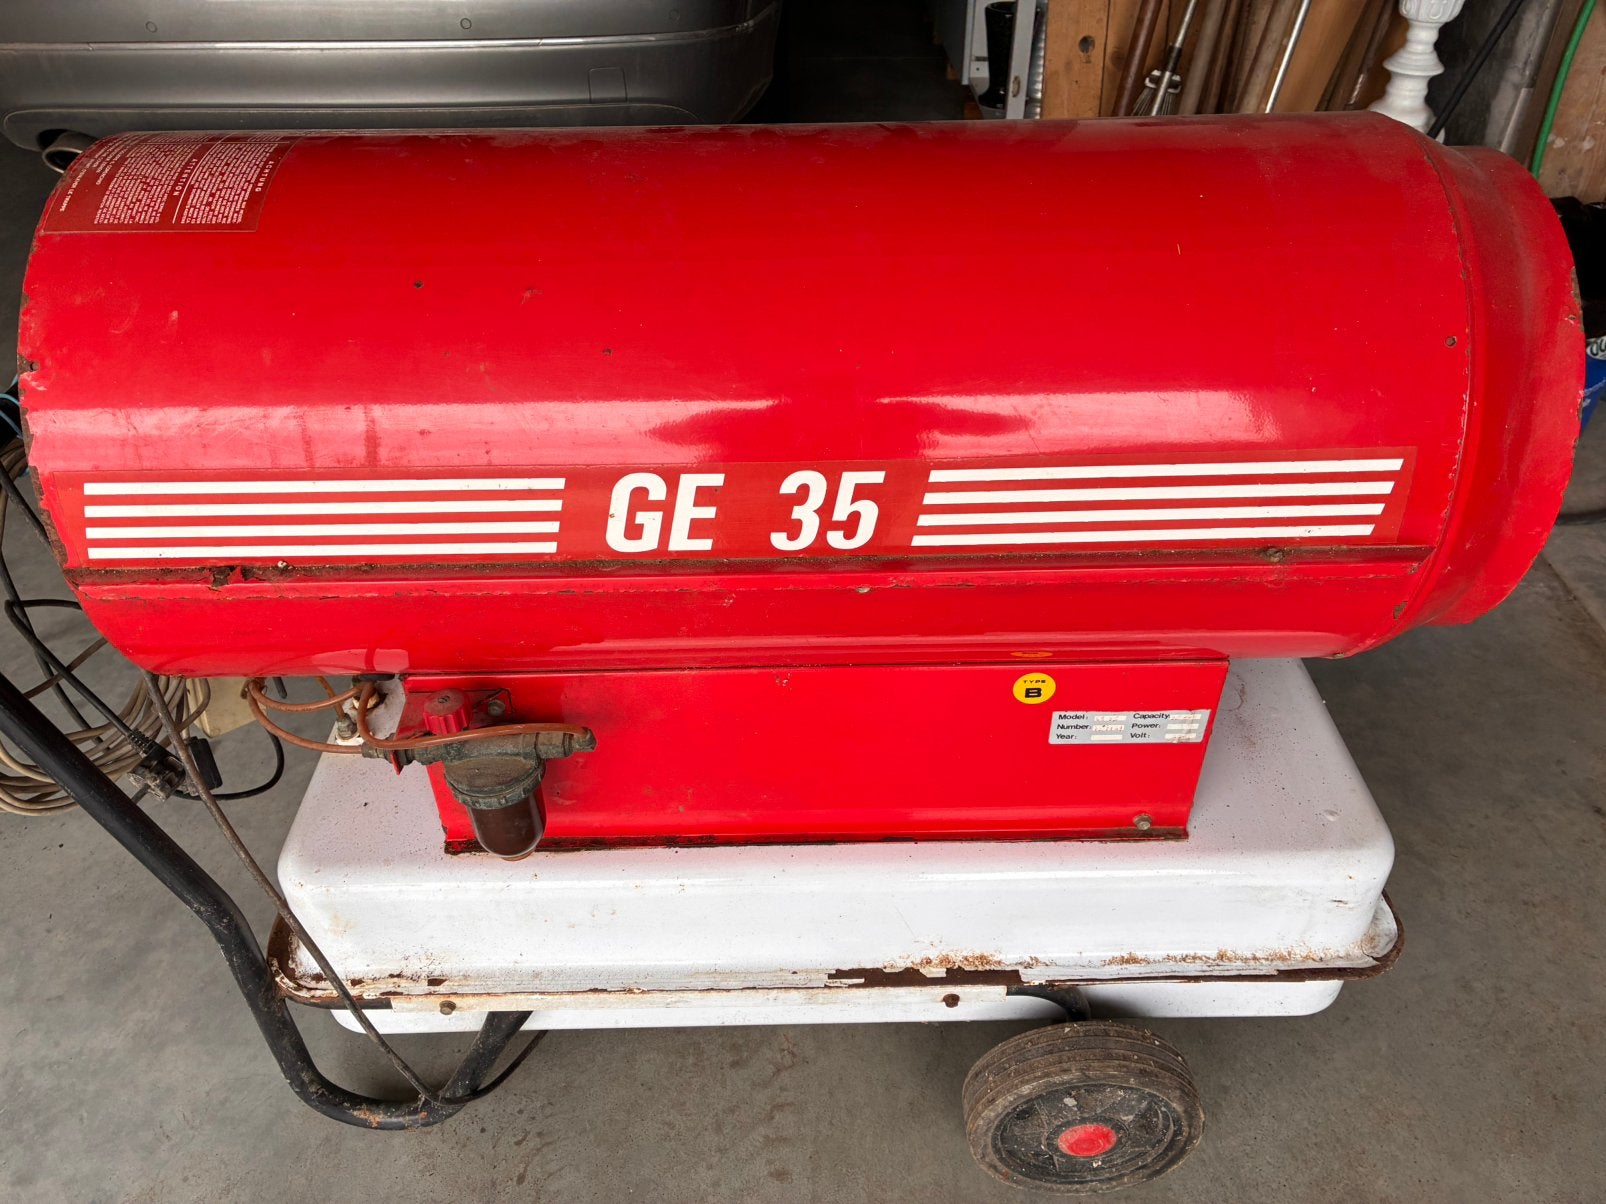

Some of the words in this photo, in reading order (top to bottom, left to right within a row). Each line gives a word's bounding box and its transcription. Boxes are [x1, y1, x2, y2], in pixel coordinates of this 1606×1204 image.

[173, 158, 198, 196] ATTENTION
[255, 160, 275, 192] ACHTUNG
[605, 472, 725, 553] GE
[770, 470, 886, 551] 35
[1025, 687, 1042, 698] B
